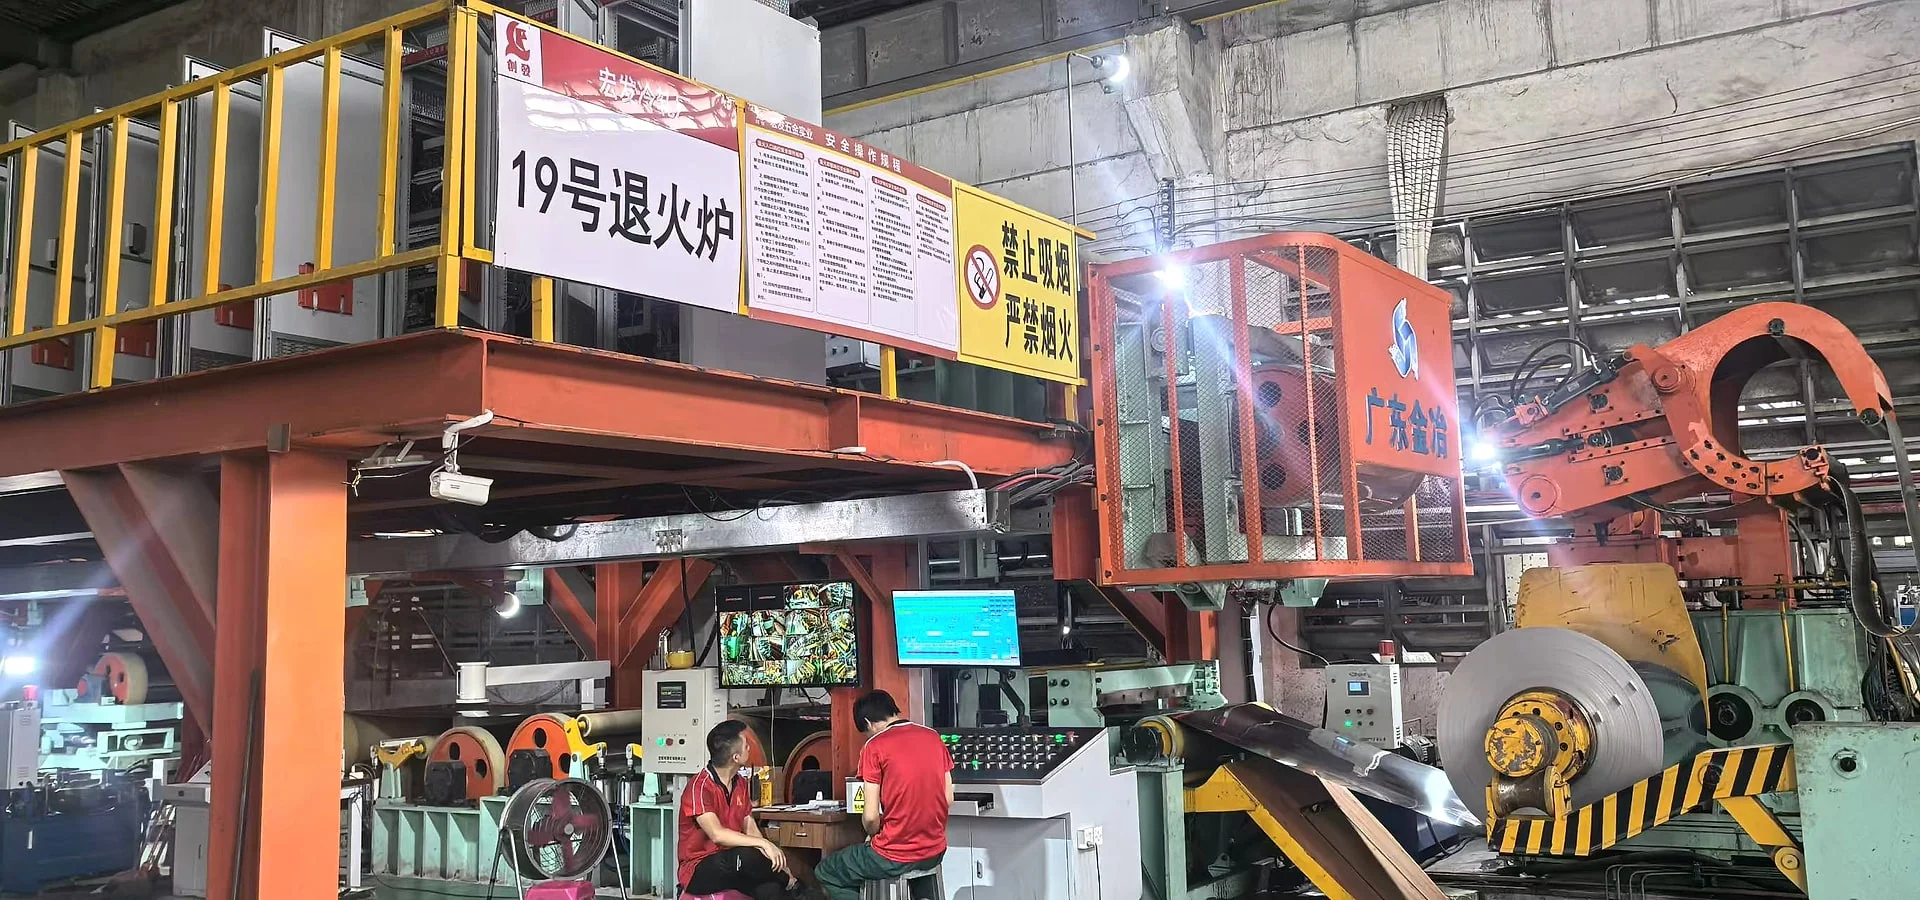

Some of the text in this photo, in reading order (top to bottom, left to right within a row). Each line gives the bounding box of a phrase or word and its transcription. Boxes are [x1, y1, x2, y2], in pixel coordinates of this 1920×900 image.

[825, 132, 902, 173] 安全操作规程
[512, 150, 734, 262] 19号退火炉
[1001, 220, 1071, 297] 禁止吸烟
[1005, 293, 1074, 362] 严禁烟火
[1365, 387, 1448, 459] 广东金冶
